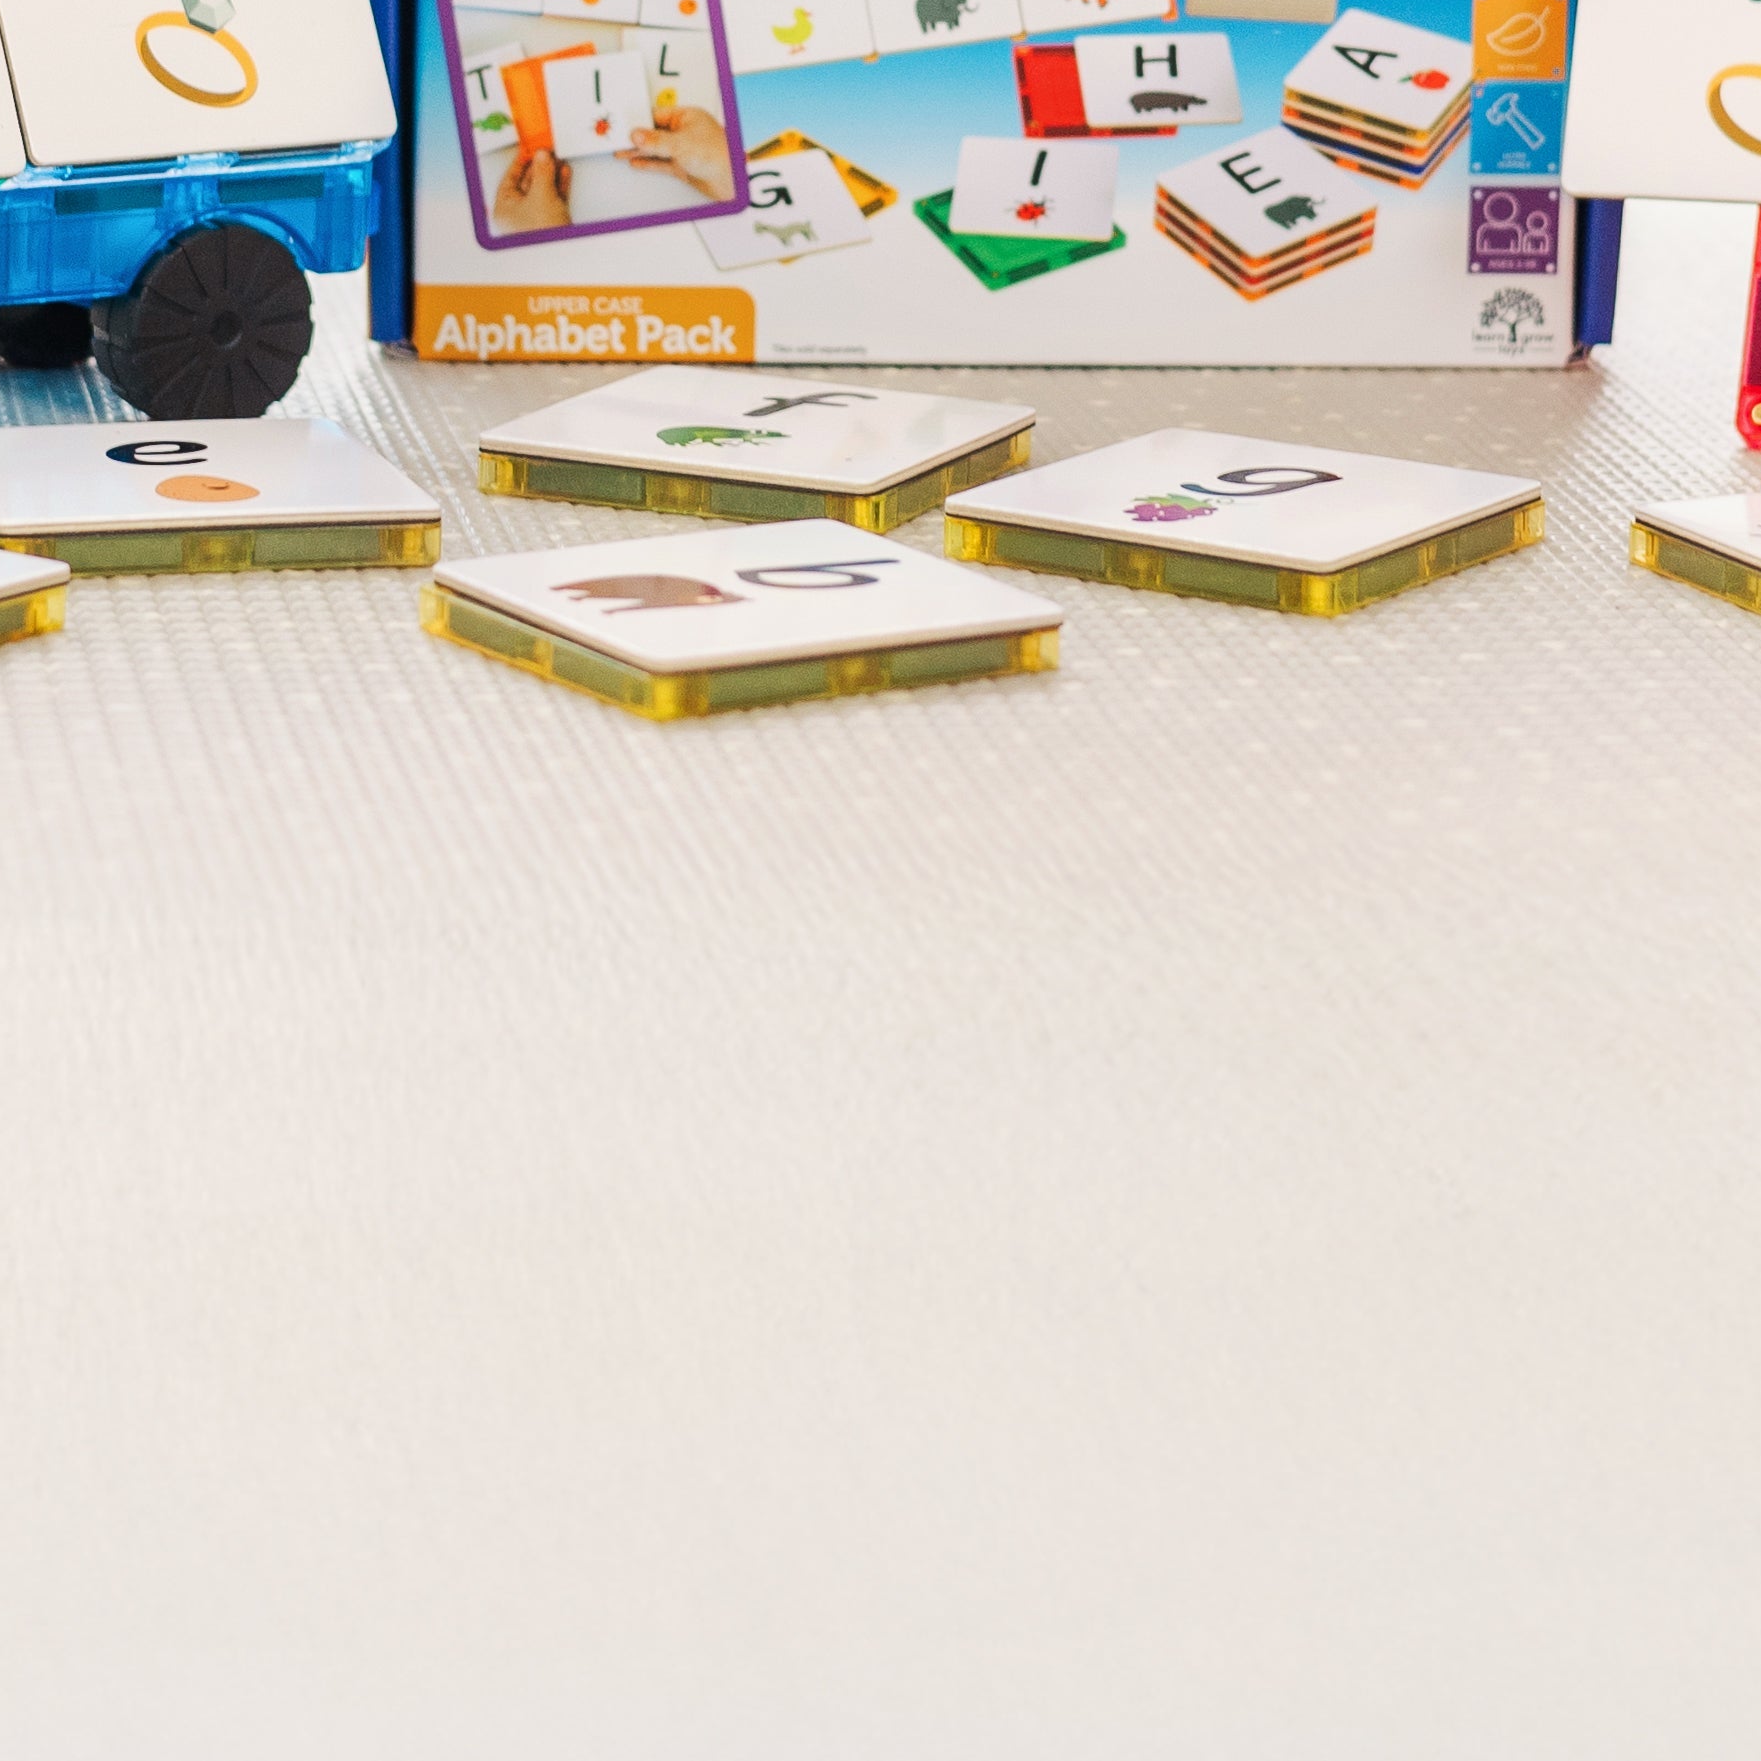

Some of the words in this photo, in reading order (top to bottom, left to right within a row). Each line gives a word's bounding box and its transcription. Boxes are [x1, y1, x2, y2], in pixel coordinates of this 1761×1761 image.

[467, 64, 492, 101] T
[658, 44, 680, 77] L
[1134, 43, 1178, 78] H
[1332, 44, 1398, 80] A
[747, 171, 793, 209] G
[1219, 151, 1282, 195] E
[527, 295, 590, 315] UPPER
[592, 295, 643, 315] CASE
[434, 314, 626, 359] Alphabet
[636, 314, 737, 355] Pack
[105, 440, 209, 466] e
